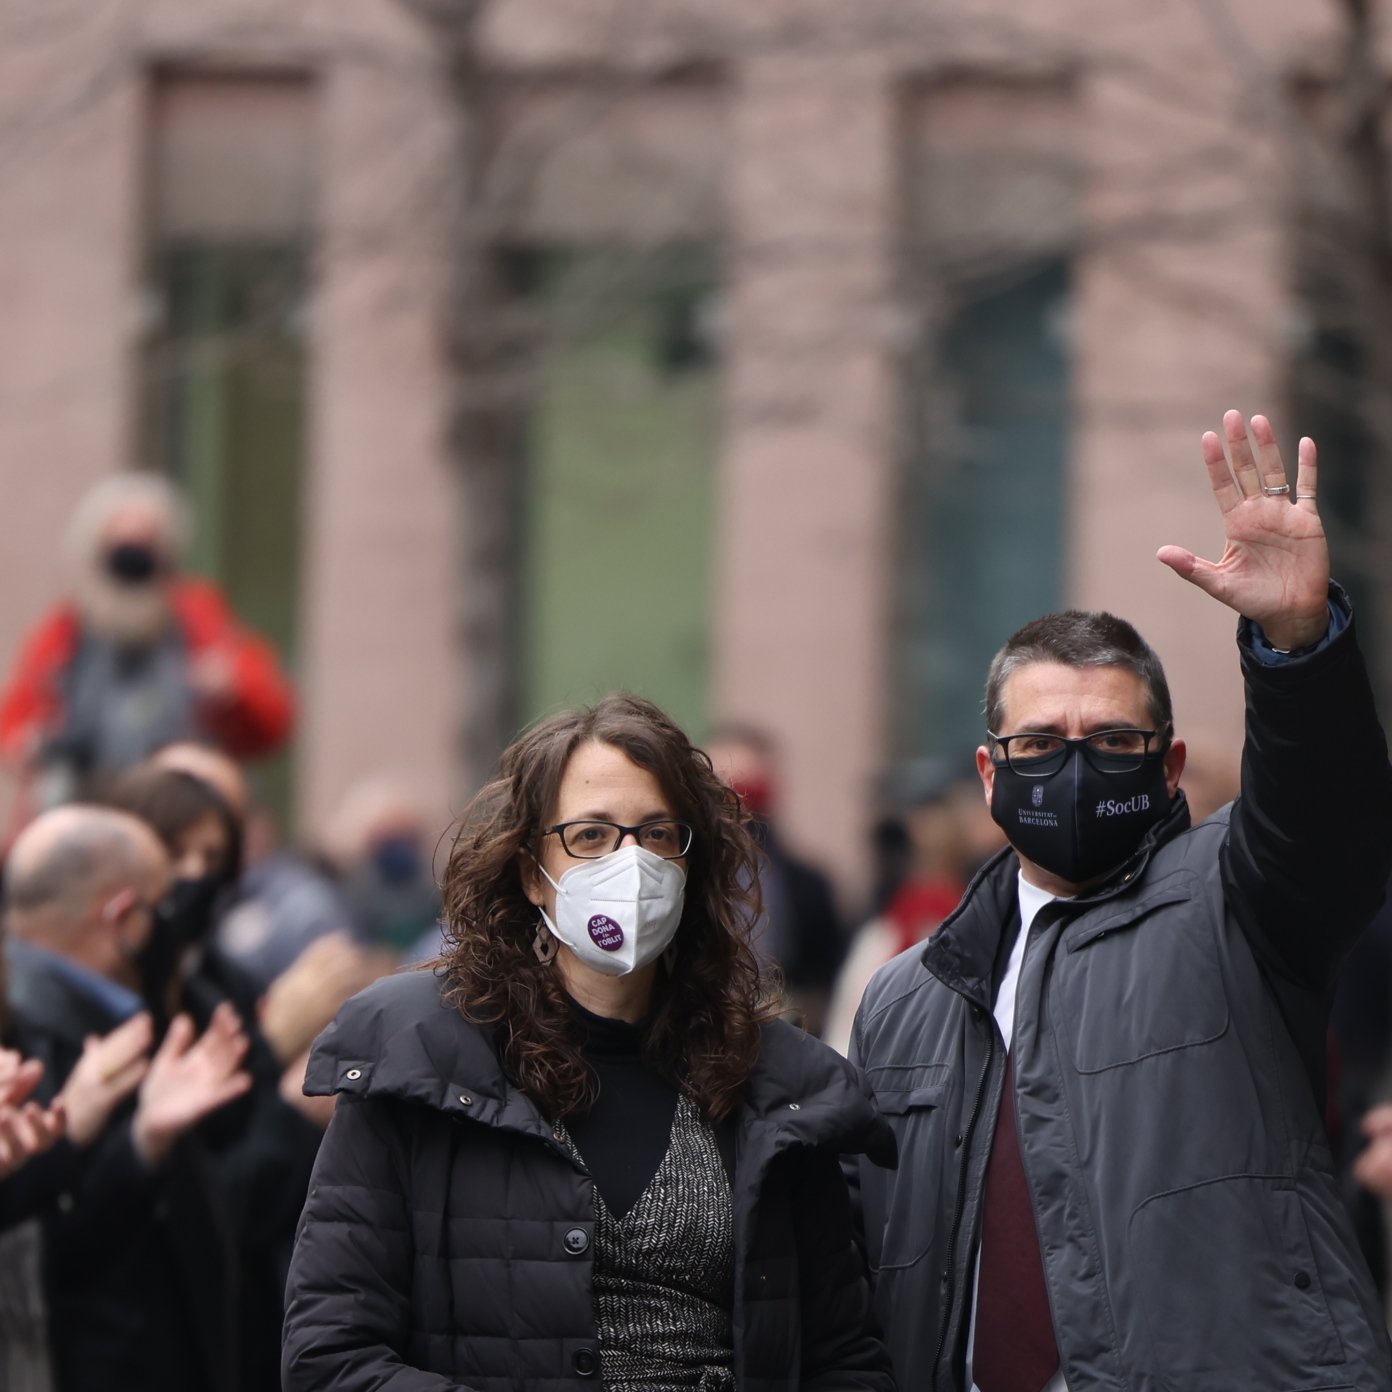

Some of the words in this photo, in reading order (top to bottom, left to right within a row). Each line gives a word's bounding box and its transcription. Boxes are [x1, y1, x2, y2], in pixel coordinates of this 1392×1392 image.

[1095, 794, 1150, 818] #SocUB
[1018, 816, 1058, 827] BARCELONA
[591, 917, 607, 927] CAP
[592, 924, 615, 935] DONA
